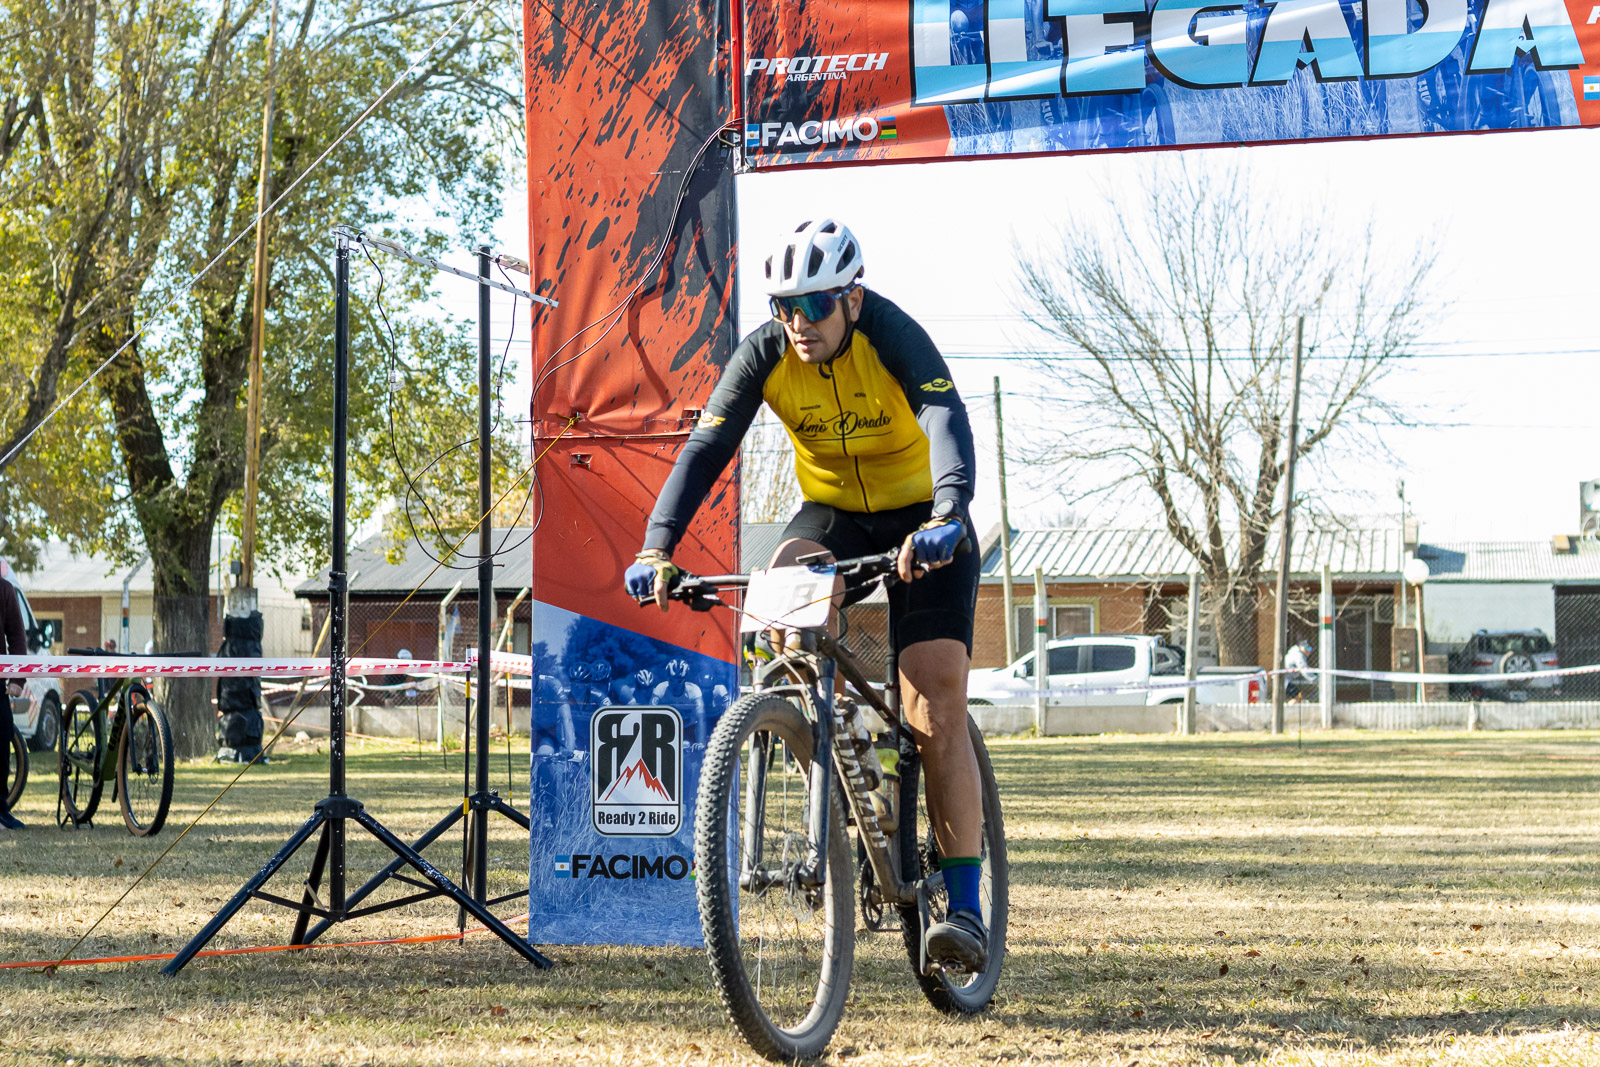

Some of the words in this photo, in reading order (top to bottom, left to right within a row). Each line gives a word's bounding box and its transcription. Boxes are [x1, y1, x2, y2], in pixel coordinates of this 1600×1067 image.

[744, 52, 890, 76] PROTECH
[909, 0, 1586, 108] LLEGADA
[785, 71, 847, 82] ARGENTINA
[762, 117, 879, 147] FACIMO
[820, 410, 892, 436] Dorado
[598, 811, 636, 826] Ready
[638, 811, 646, 825] 2
[649, 811, 676, 825] Ride
[572, 854, 689, 880] FACIMO
